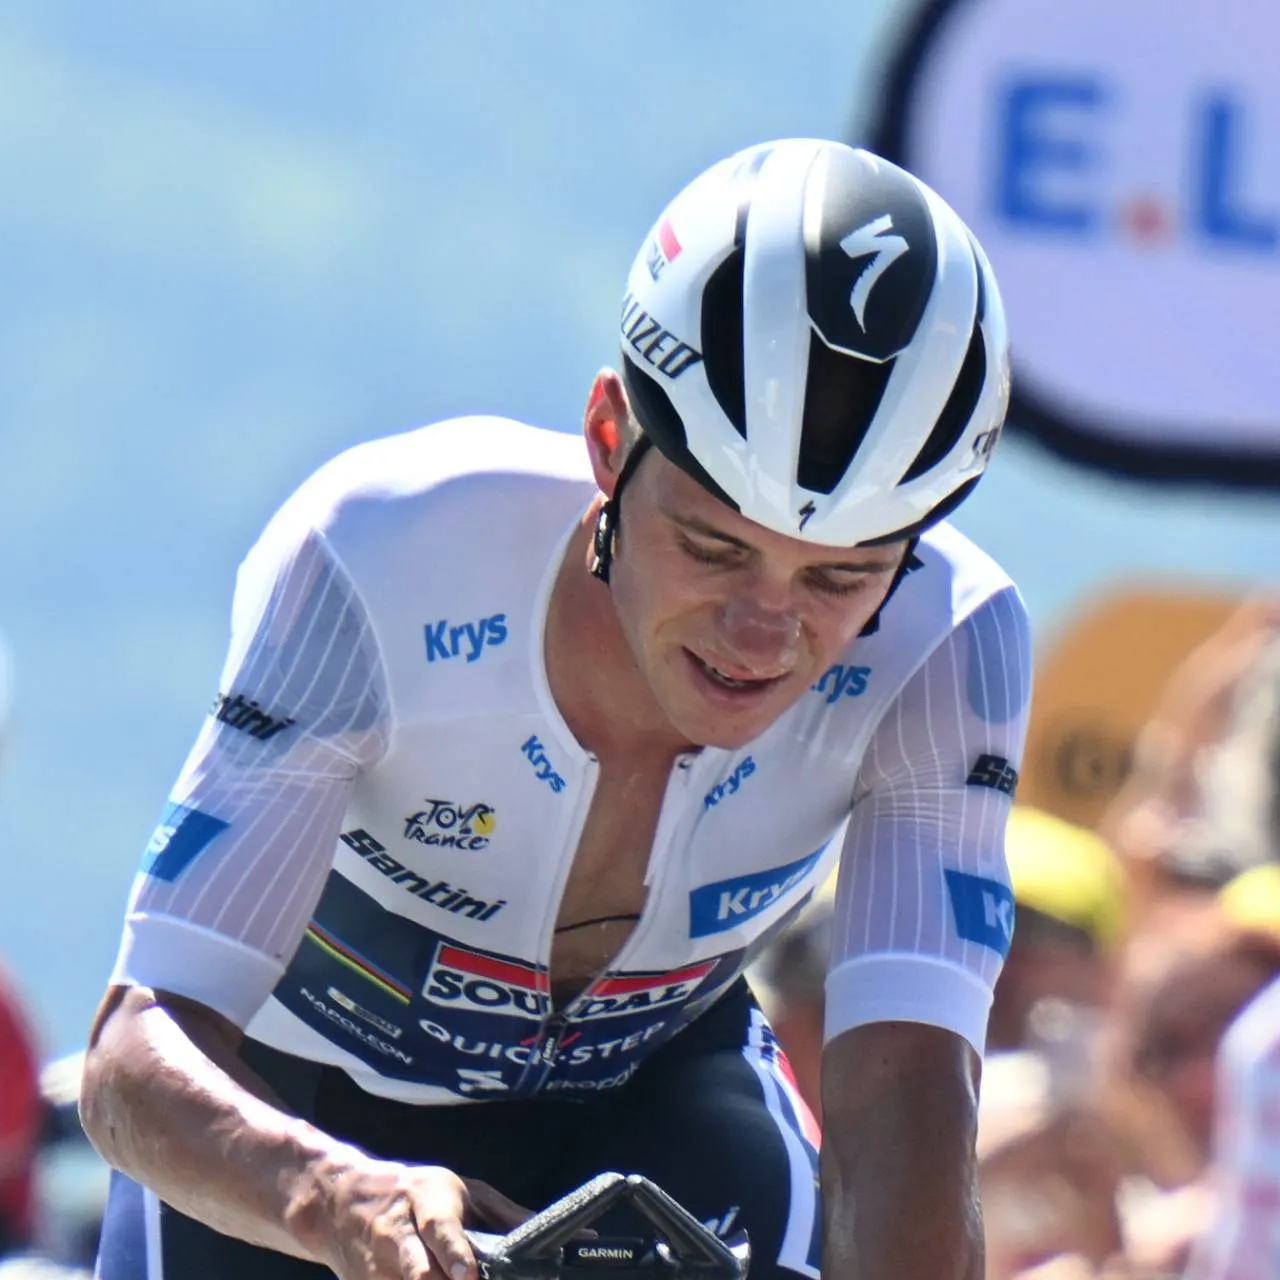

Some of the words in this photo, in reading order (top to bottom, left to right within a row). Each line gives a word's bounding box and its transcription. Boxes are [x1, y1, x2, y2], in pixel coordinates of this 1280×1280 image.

[424, 614, 508, 663] Krys
[810, 663, 873, 705] rys
[521, 735, 567, 794] Krys
[339, 829, 507, 922] Santini
[428, 968, 690, 1019] SOUDAL
[300, 986, 413, 1065] NAPOLEON
[577, 1246, 634, 1260] GARMIN
